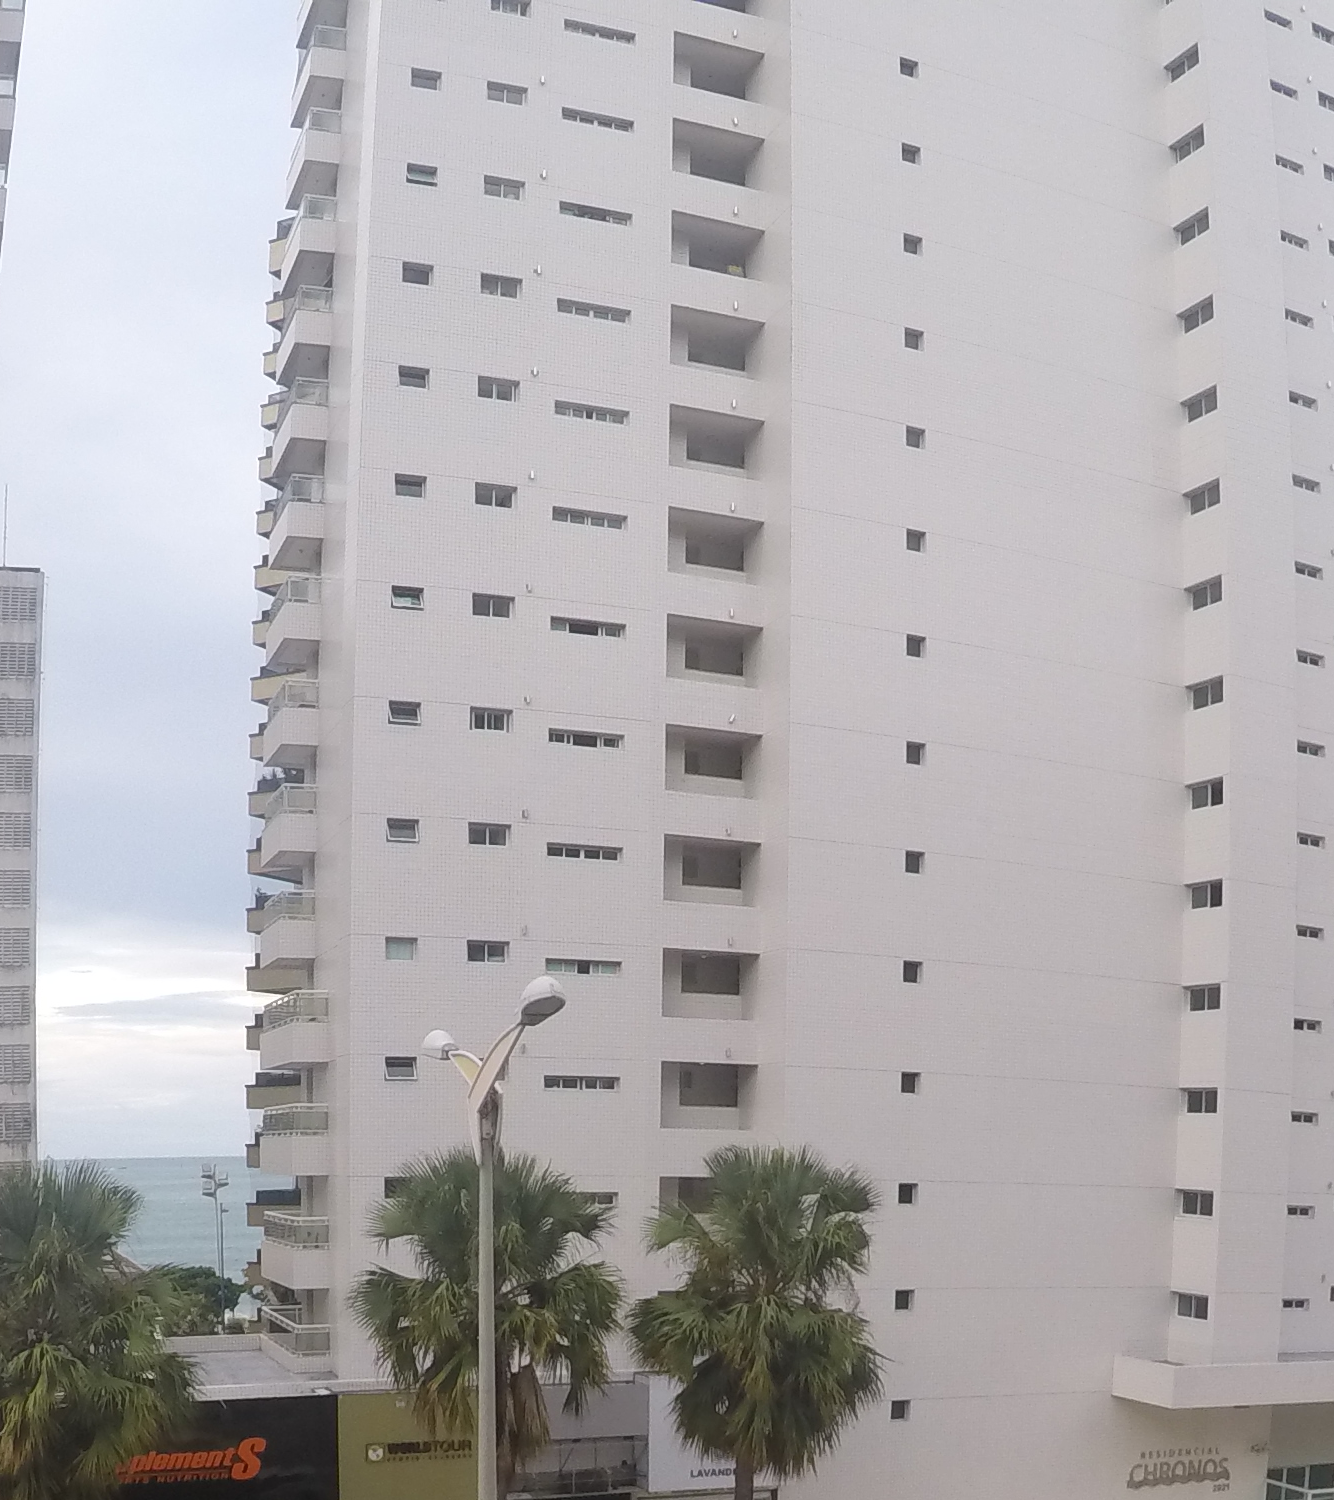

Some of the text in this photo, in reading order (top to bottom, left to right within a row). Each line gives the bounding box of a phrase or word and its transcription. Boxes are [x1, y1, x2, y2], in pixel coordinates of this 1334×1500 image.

[116, 1437, 267, 1480] plementS
[1128, 1457, 1231, 1486] CHRONOS
[156, 1472, 230, 1484] NUTRITION
